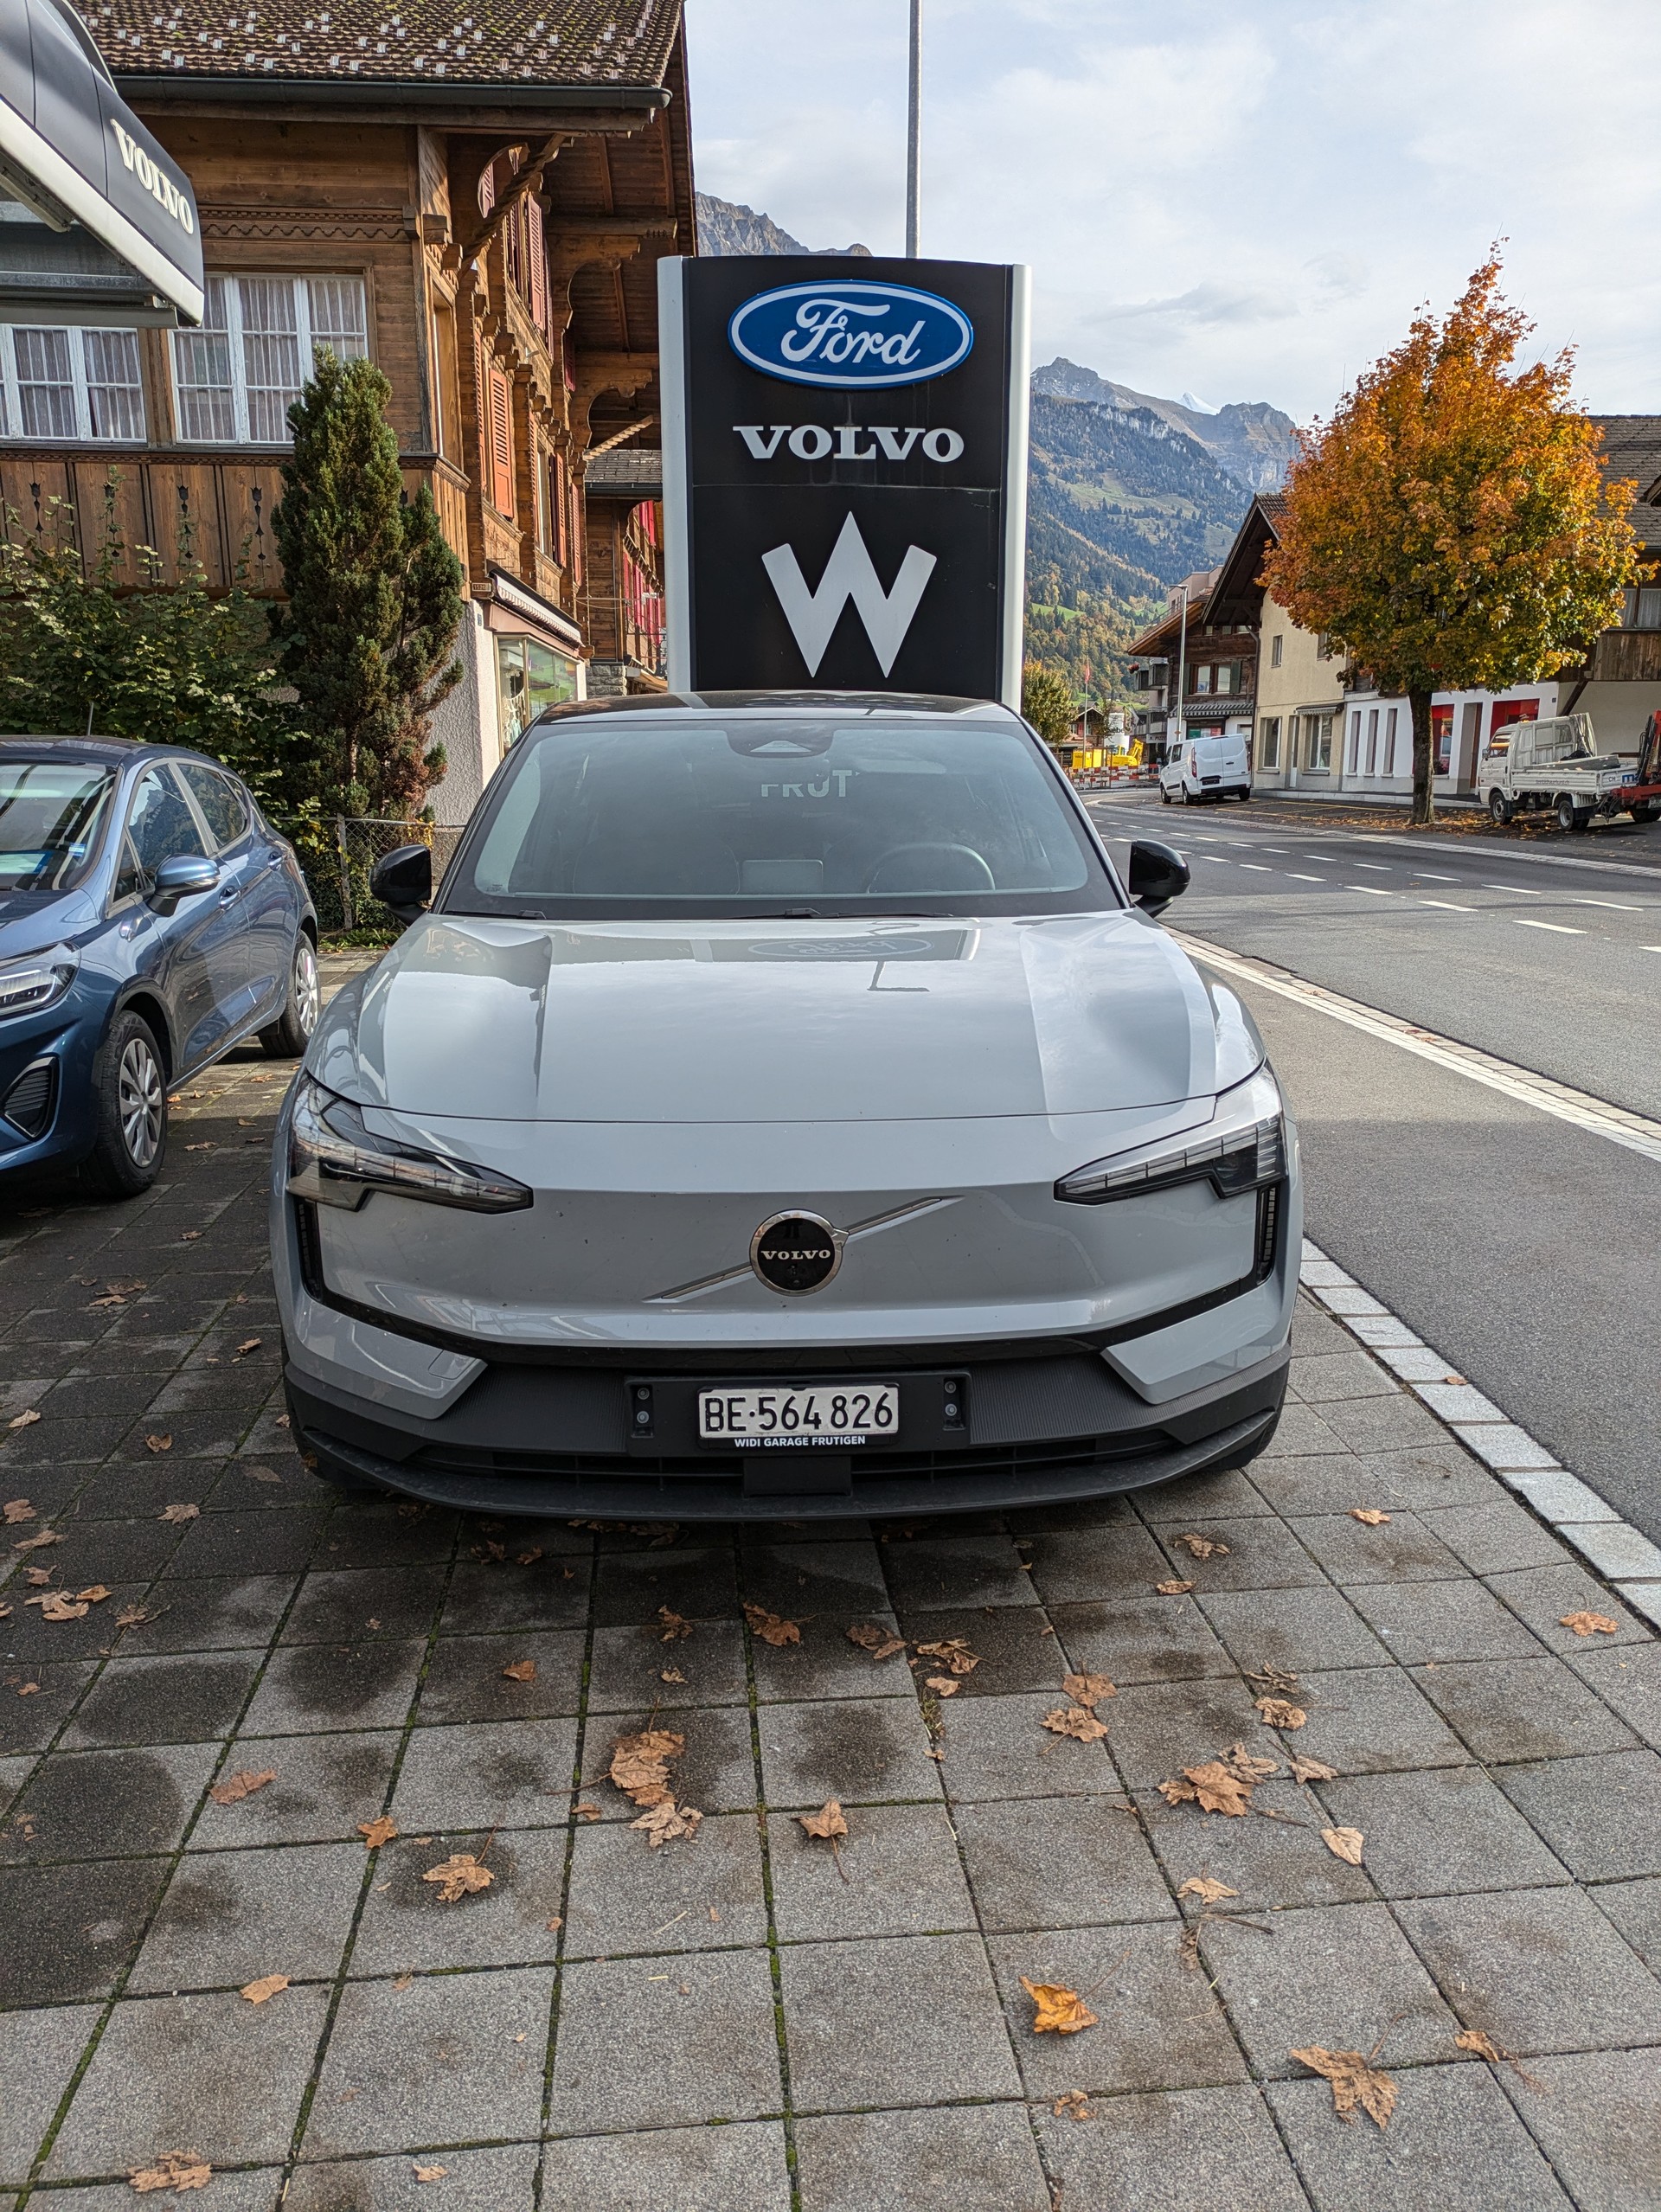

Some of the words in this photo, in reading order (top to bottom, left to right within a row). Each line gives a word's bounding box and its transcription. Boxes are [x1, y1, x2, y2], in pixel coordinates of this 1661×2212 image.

[110, 119, 194, 234] VOLVO
[780, 298, 926, 365] Ford
[733, 425, 965, 463] VOLVO
[760, 1249, 831, 1260] VOLVO
[734, 1438, 760, 1447] WIDI
[764, 1437, 809, 1447] GARAGE
[811, 1435, 866, 1446] FRUTIGEN
